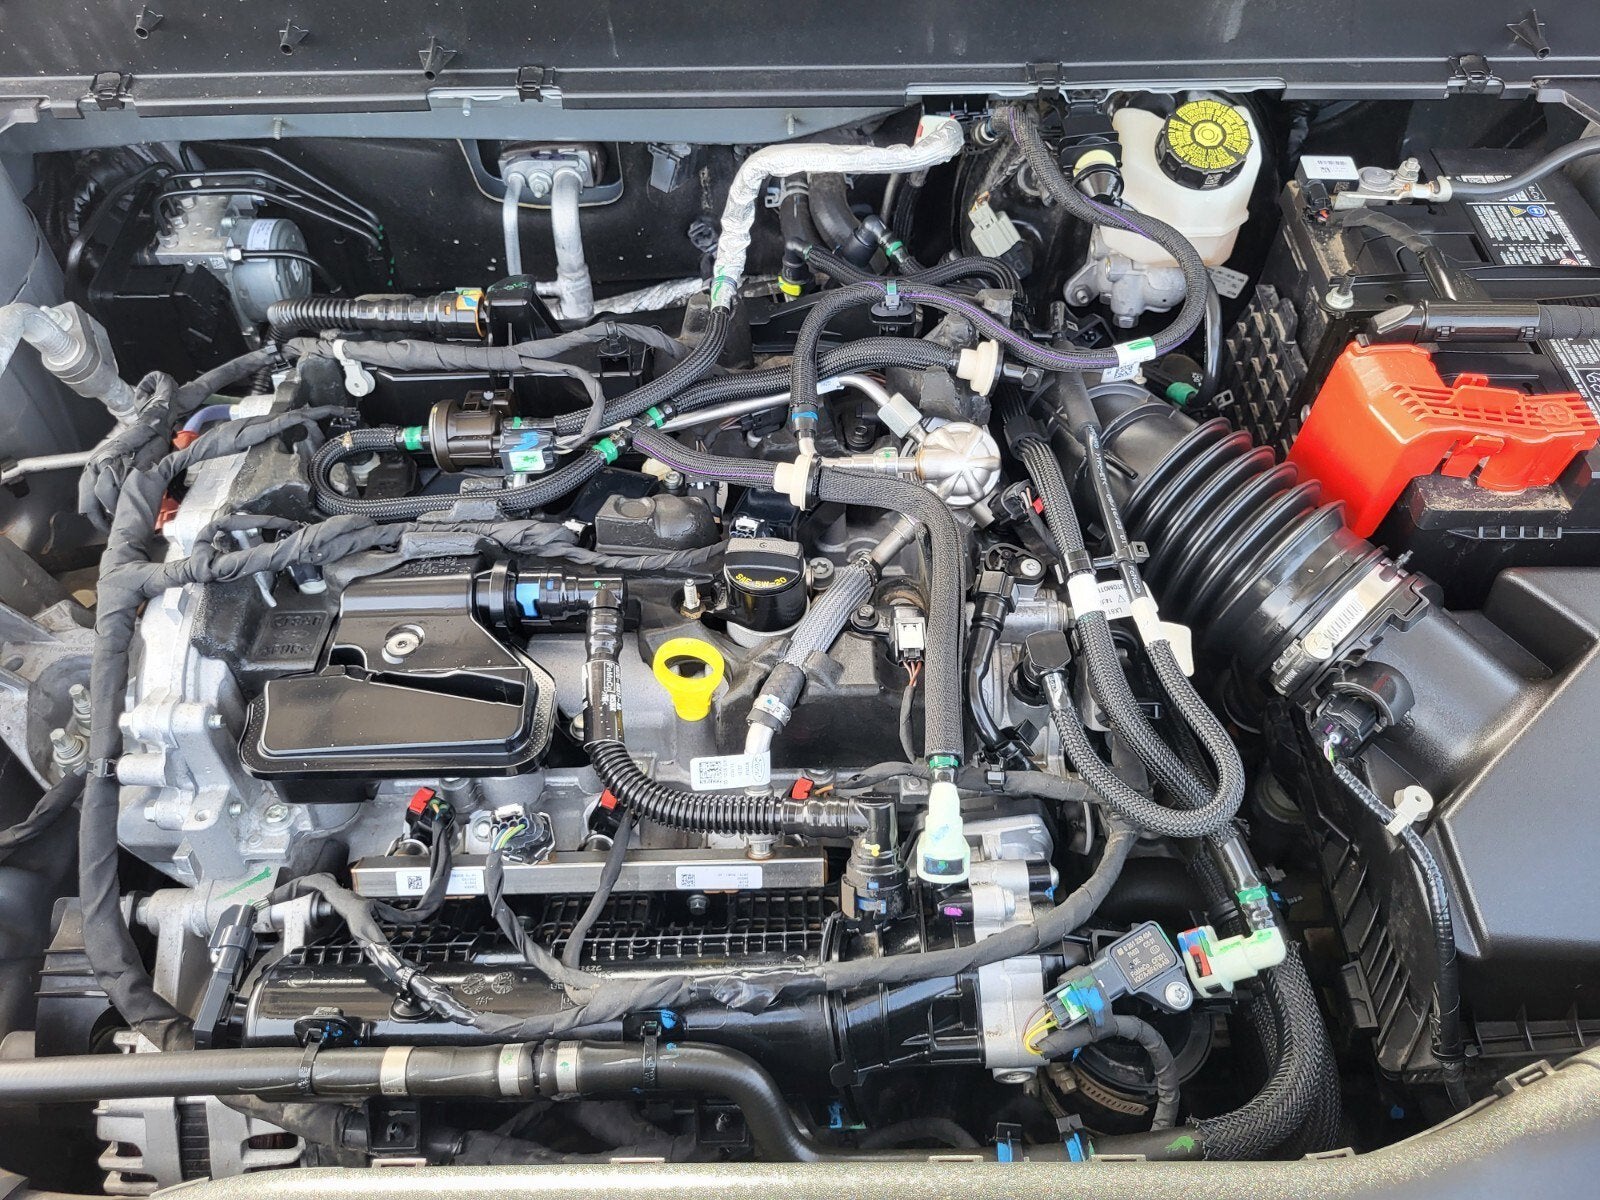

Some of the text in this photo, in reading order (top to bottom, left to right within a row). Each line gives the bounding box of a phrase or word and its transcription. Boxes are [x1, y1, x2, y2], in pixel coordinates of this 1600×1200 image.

[735, 573, 787, 587] SAE 5W-20
[1128, 565, 1141, 594] FoMoCo
